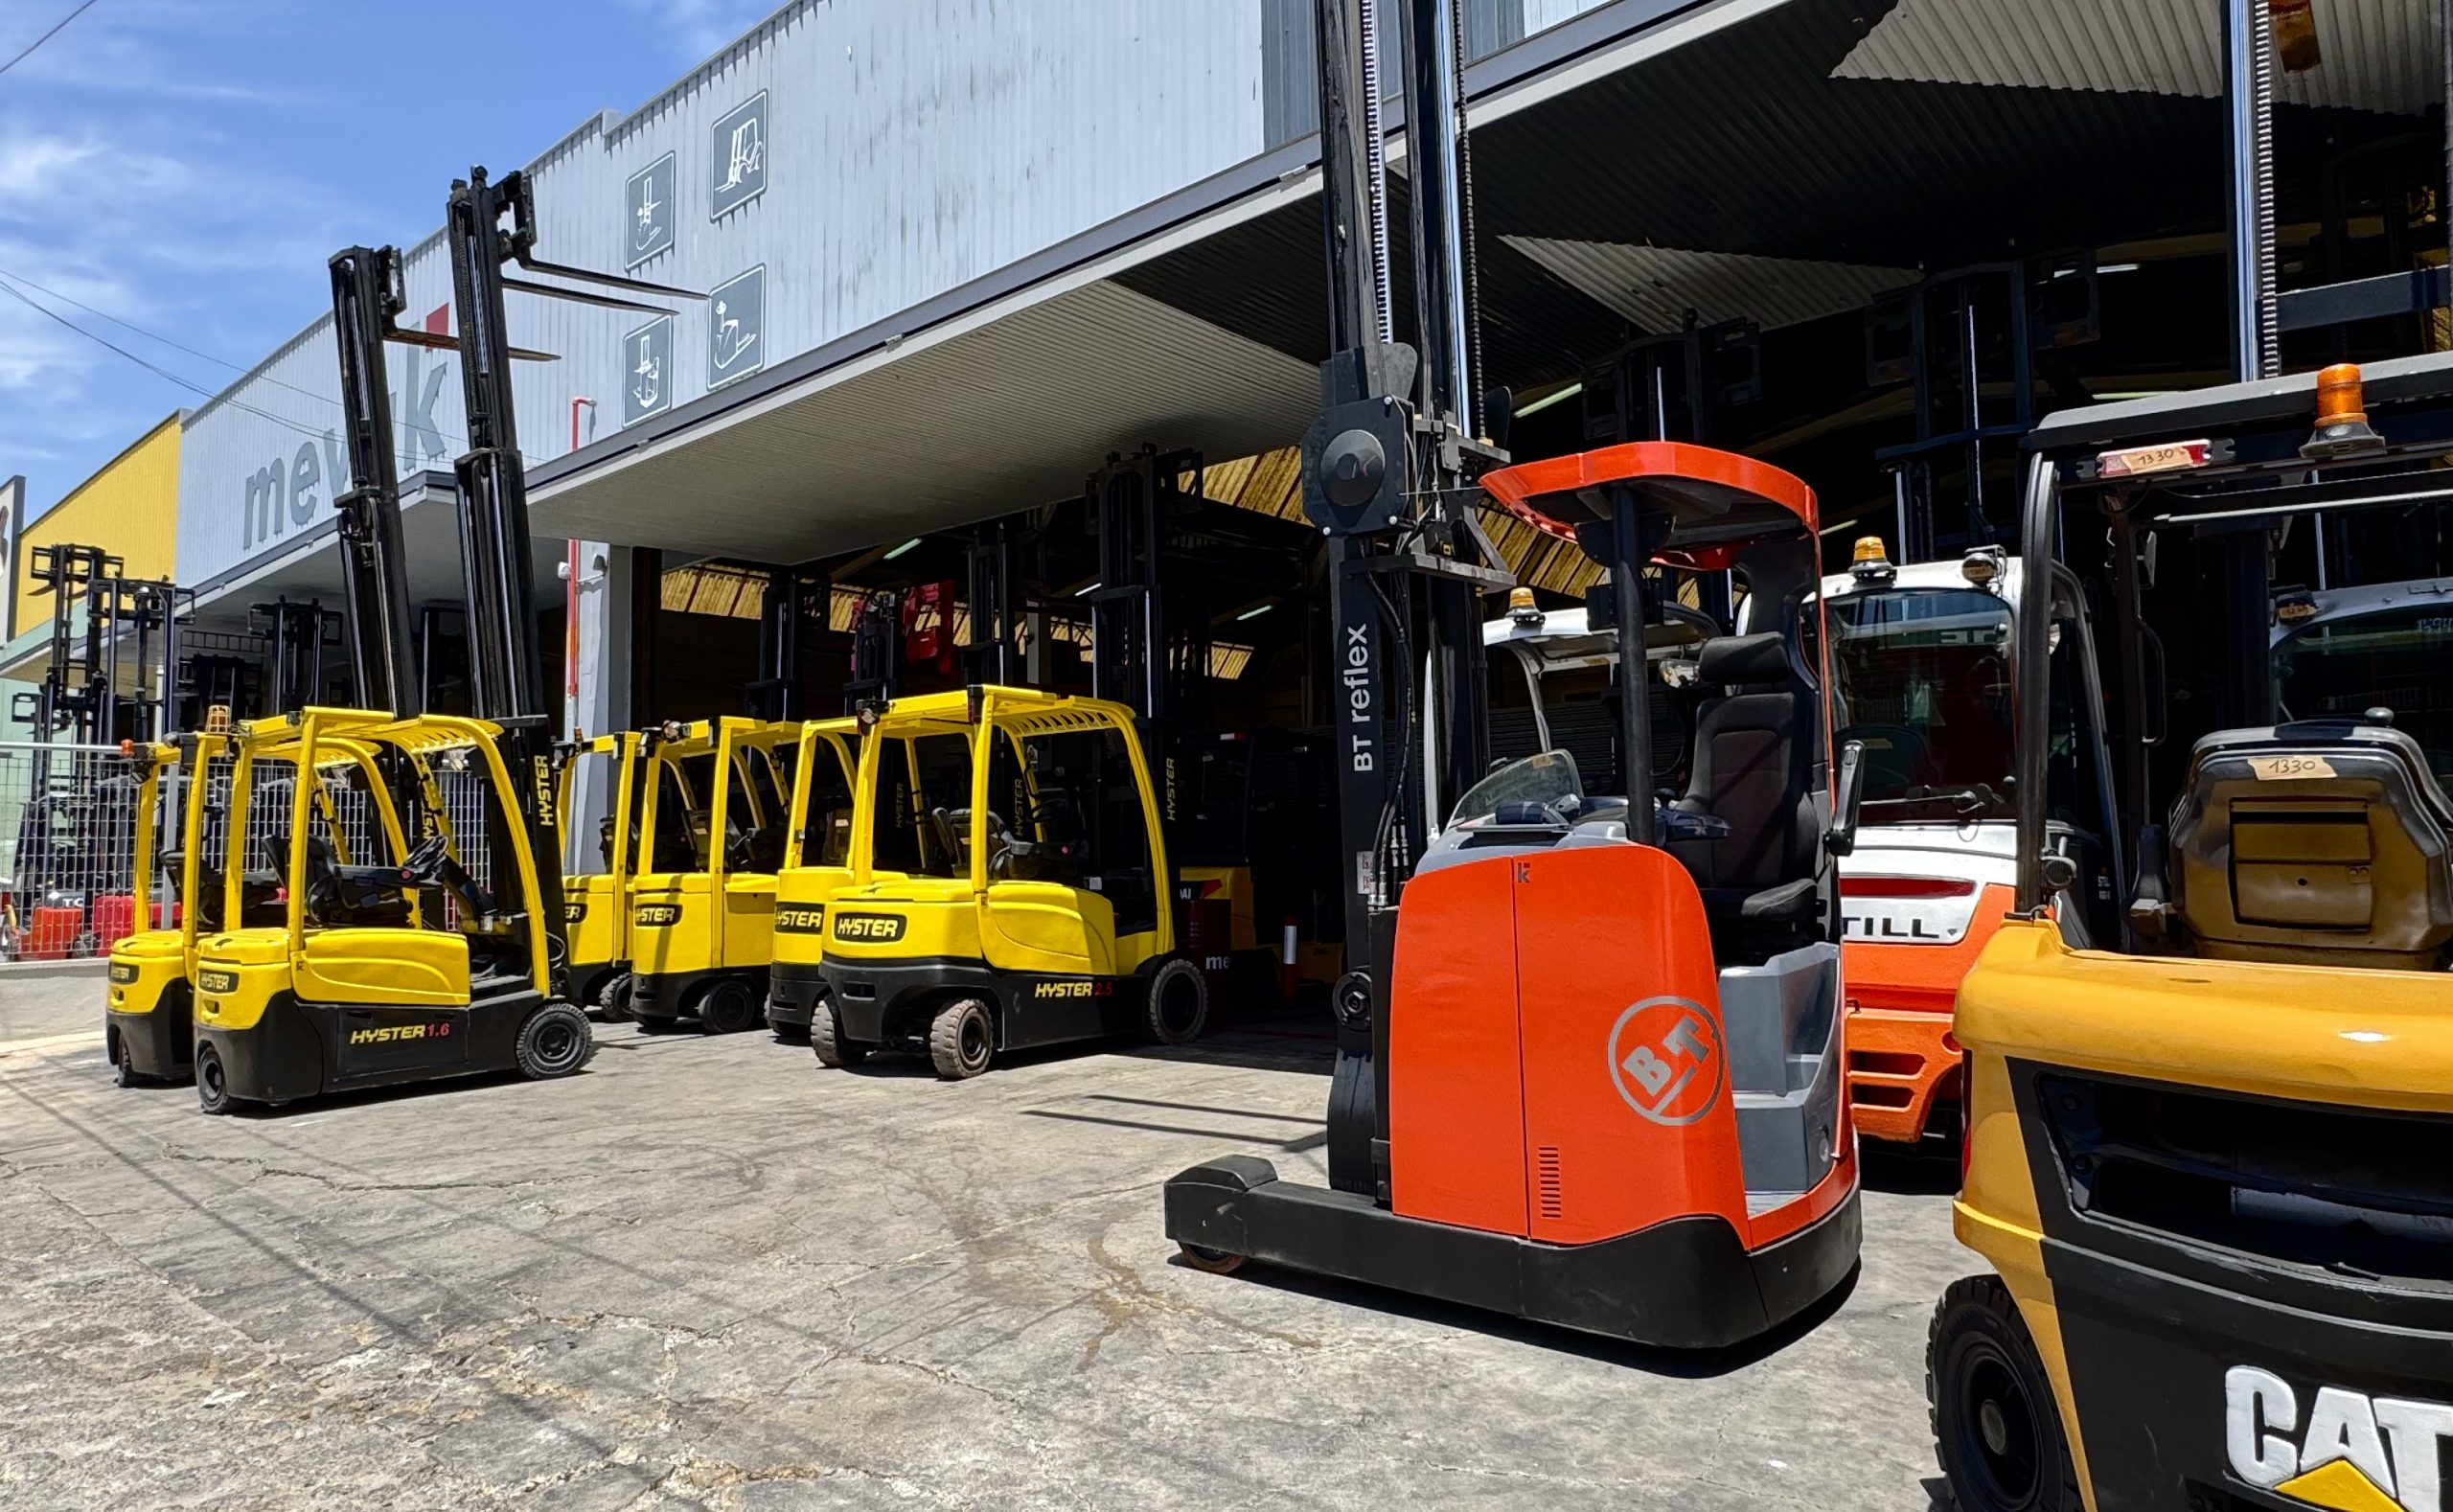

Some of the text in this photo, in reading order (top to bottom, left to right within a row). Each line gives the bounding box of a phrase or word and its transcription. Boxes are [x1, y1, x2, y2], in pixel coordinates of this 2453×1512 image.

[243, 319, 449, 553] mevk
[2138, 447, 2174, 467] 1330
[1342, 623, 1374, 772] BT reflex
[2268, 758, 2317, 774] 1330
[534, 754, 554, 827] HYSTER
[1014, 778, 1024, 837] HYSTER
[1165, 757, 1177, 821] HYSTER
[774, 910, 823, 928] YSTER
[837, 917, 899, 938] HYSTER
[1842, 917, 1940, 939] TILL
[1035, 982, 1093, 998] HYSTER
[350, 1022, 450, 1044] HYSTER 1.6
[1620, 1015, 1710, 1097] BT
[2225, 1364, 2453, 1512] CAT
